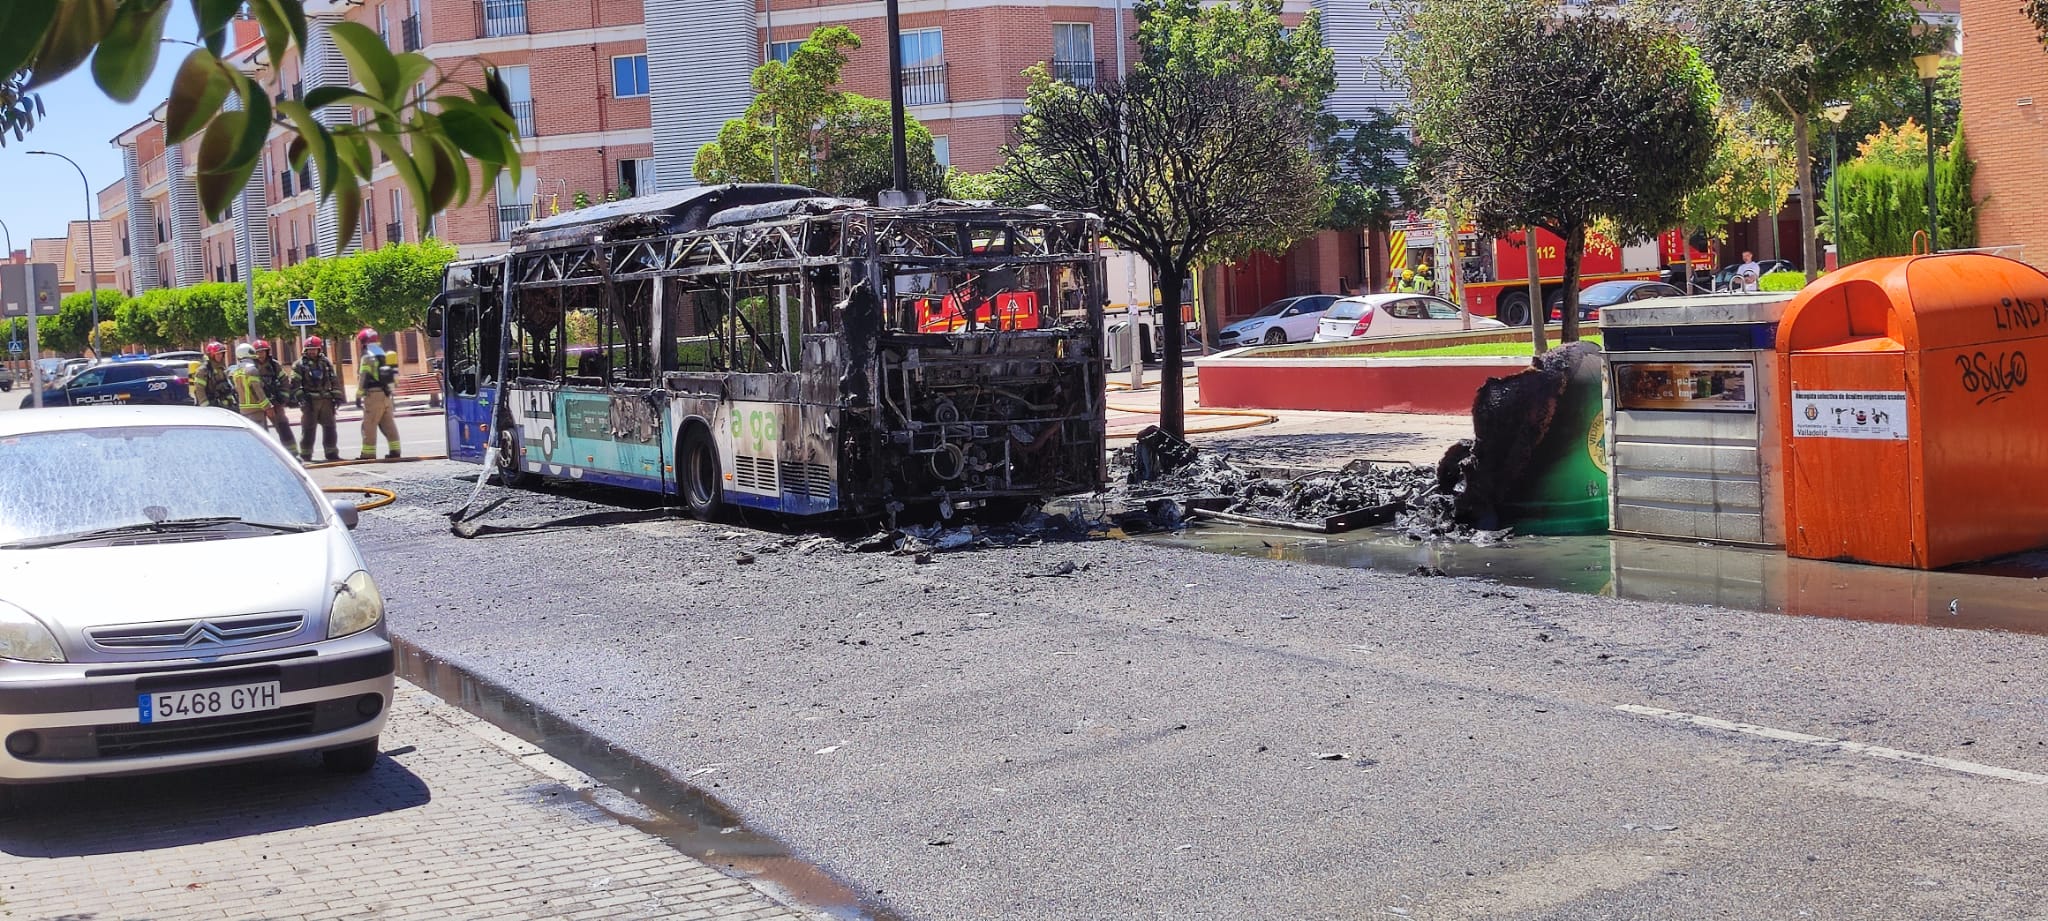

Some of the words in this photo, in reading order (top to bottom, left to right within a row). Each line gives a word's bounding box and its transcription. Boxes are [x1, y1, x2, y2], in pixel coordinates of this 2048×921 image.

[1537, 246, 1556, 259] 112
[76, 394, 120, 404] POLICIA
[159, 691, 221, 717] 5468
[231, 684, 275, 710] GYH
